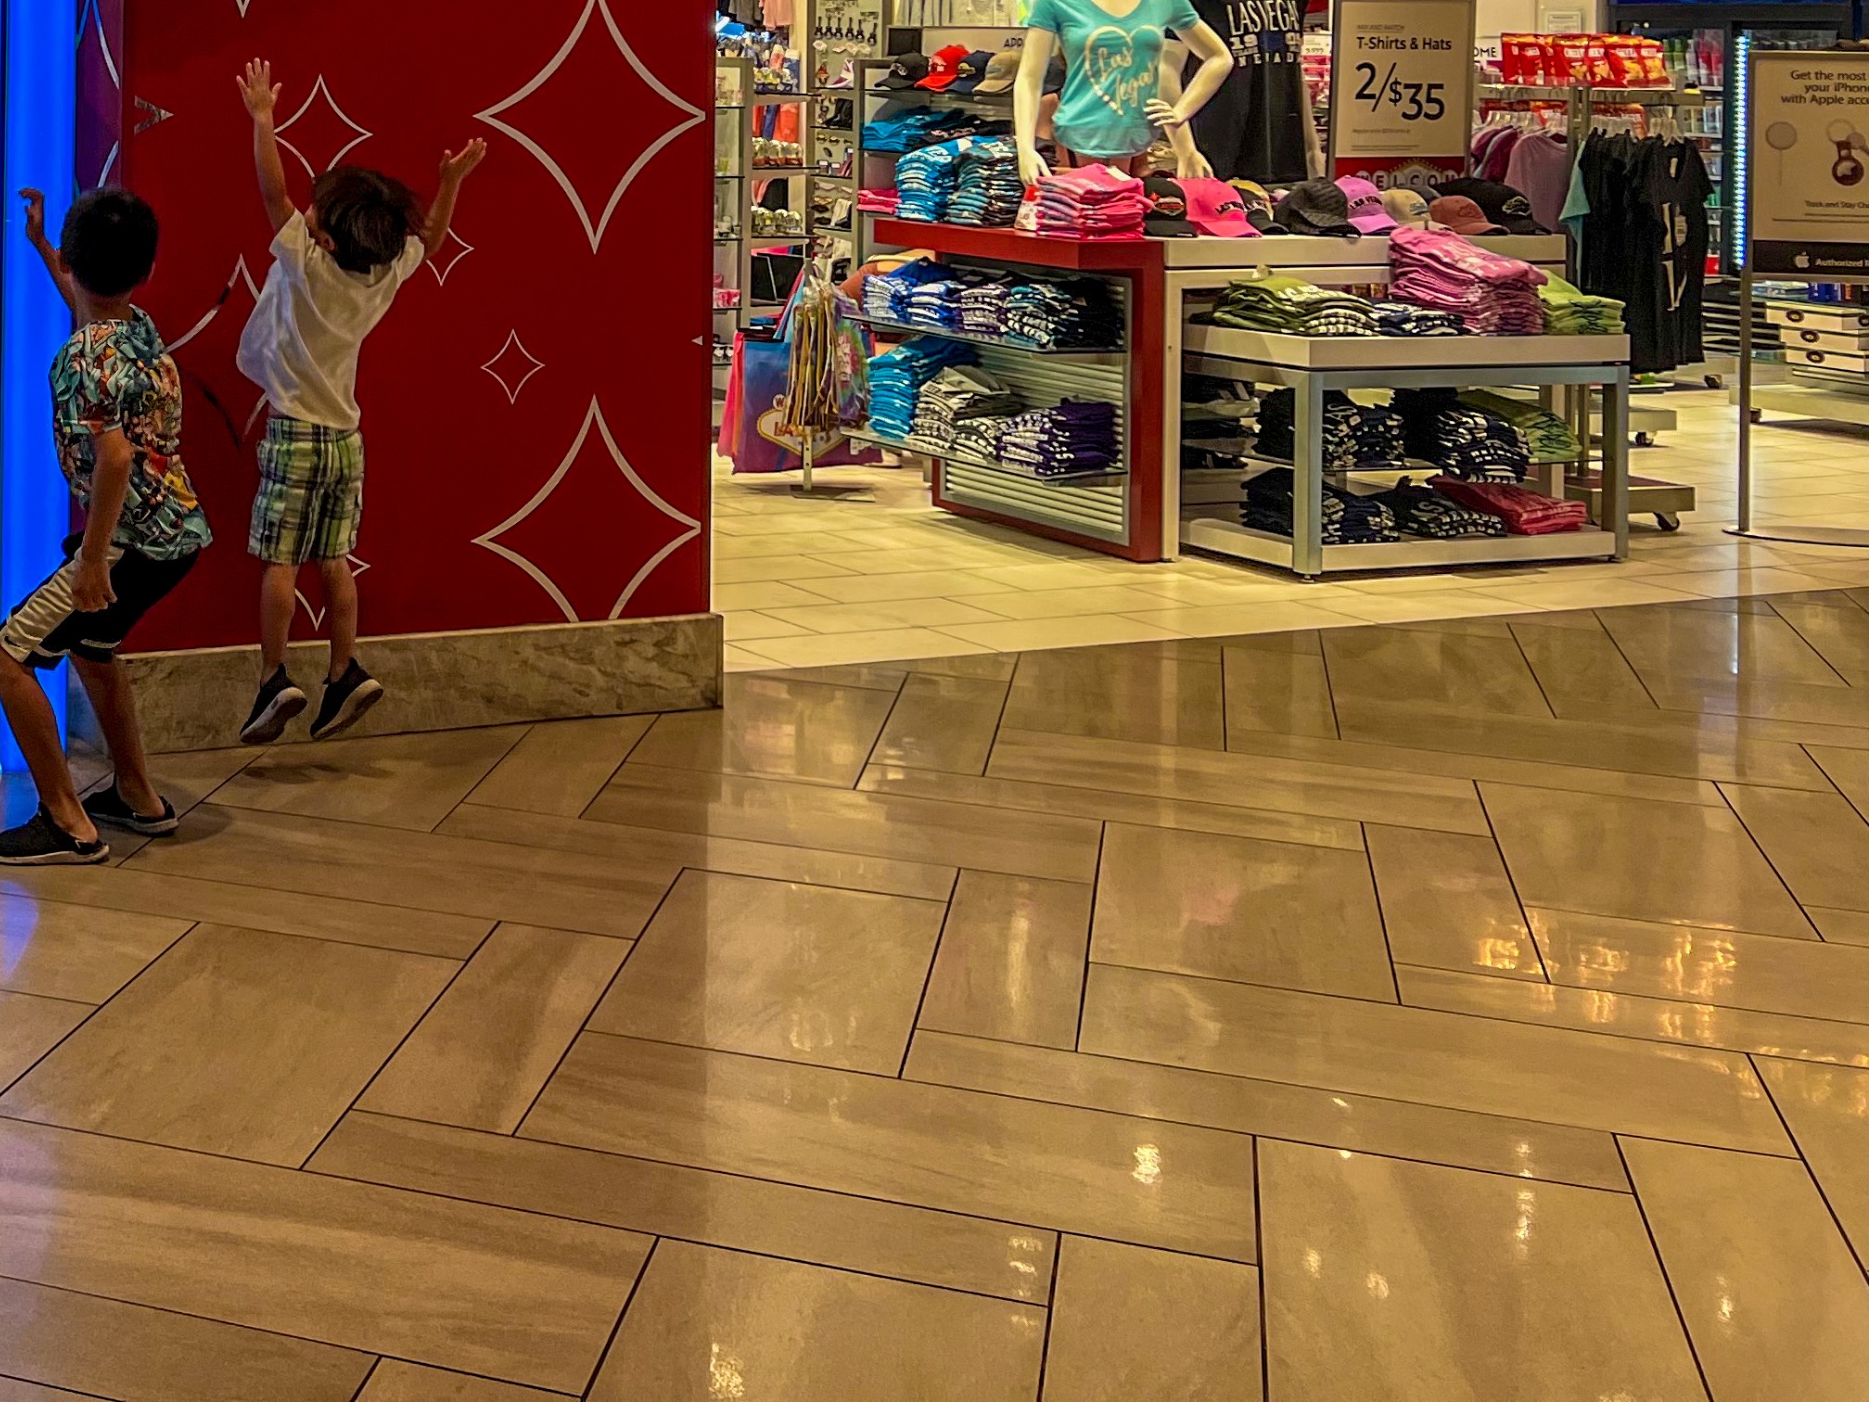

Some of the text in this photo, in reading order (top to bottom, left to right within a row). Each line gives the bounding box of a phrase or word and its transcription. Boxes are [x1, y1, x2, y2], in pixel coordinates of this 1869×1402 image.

[1226, 0, 1262, 36] LAS
[1356, 36, 1452, 51] T-Shirts & Hats
[1791, 70, 1866, 81] Get the most
[1355, 61, 1446, 121] 2/$35
[1804, 82, 1869, 96] your iPhon
[1781, 94, 1844, 106] with Apple
